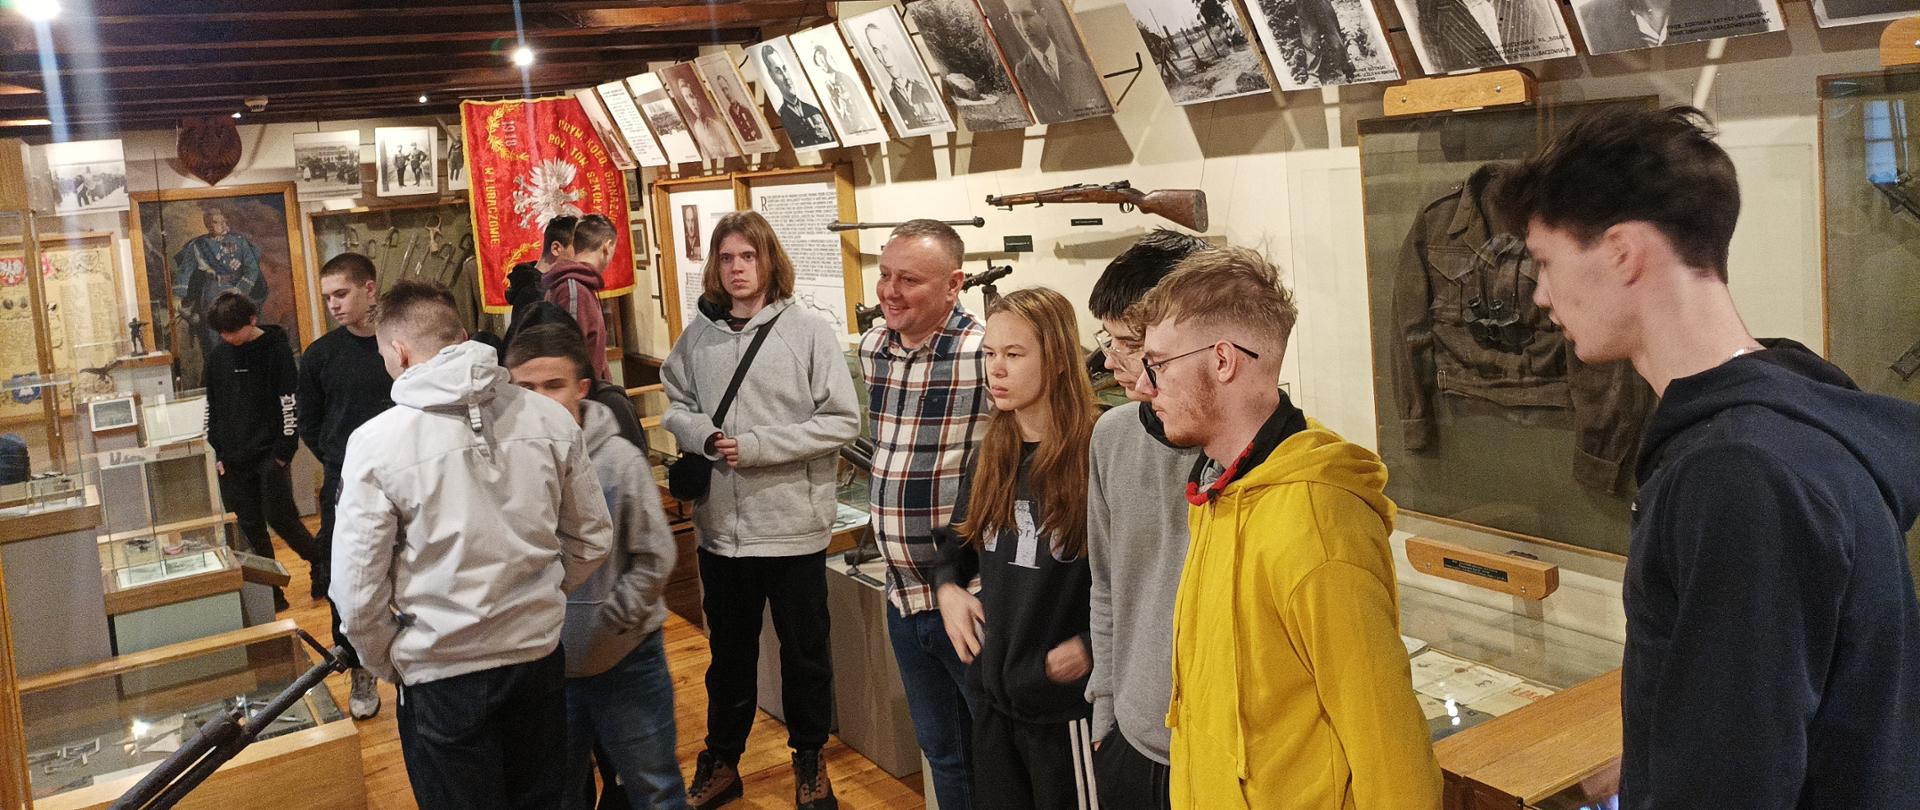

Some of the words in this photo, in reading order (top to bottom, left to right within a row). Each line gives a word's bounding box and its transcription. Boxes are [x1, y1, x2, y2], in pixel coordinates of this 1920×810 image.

[502, 120, 518, 147] 1918
[558, 119, 584, 141] PRYW.
[585, 138, 608, 167] KOED.
[484, 167, 494, 175] W
[586, 171, 603, 213] SZKOŁY
[485, 178, 501, 246] LUBACZOWIE
